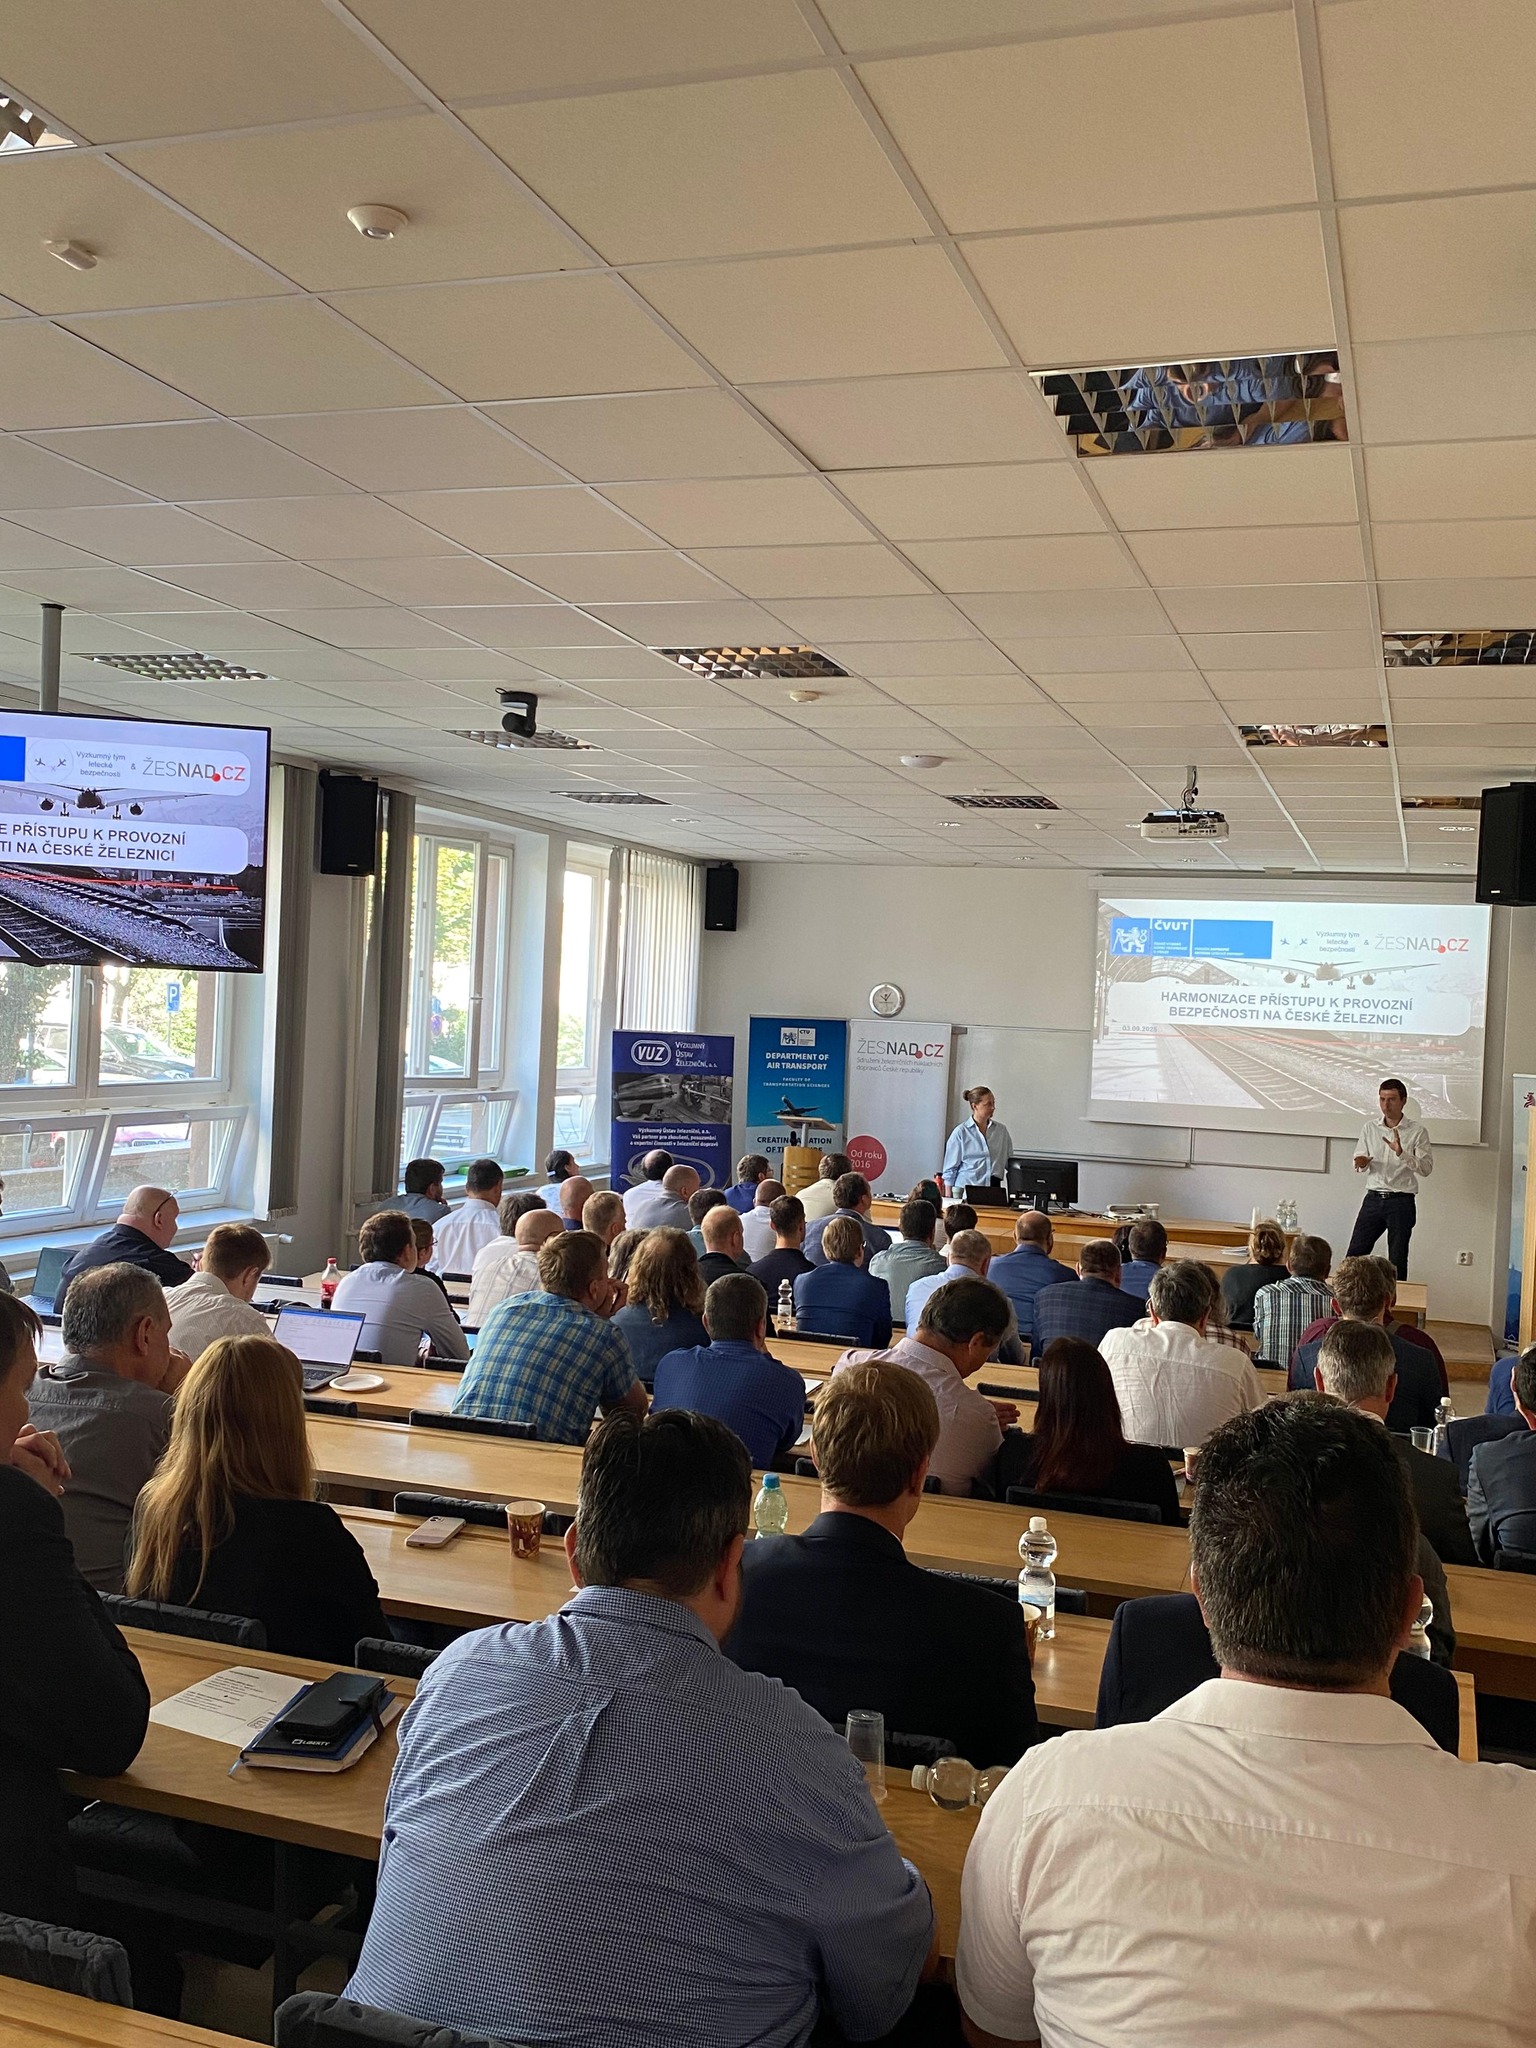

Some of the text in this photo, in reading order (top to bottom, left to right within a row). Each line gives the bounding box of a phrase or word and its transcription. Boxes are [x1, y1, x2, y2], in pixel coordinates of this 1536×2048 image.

[76, 751, 126, 762] Výzkumný tým
[88, 761, 113, 769] letecké
[142, 757, 246, 782] ŽESNAD.CZ
[80, 769, 121, 778] bezpečnosti
[12, 821, 88, 840] PŘÍSTUPU
[93, 829, 104, 841] K
[108, 829, 186, 846] PROVOZNÍ
[16, 841, 38, 854] NA
[42, 840, 94, 857] ČESKÉ
[97, 843, 175, 862] ŽELEZNICI
[1154, 919, 1189, 931] ČVUT
[1316, 931, 1347, 939] Výzkumný
[1374, 933, 1470, 953] ŽESNAD.CZ
[170, 986, 178, 1003] P
[1161, 991, 1413, 1011] HARMONIZACE PŘÍSTUPU K PROVOZNÍ
[1169, 1006, 1403, 1025] BEZPEČNOSTI NA ČESKÉ ŽELEZNICI
[638, 1046, 665, 1061] VUZ
[856, 1038, 944, 1059] ŽESNAD.CZ
[765, 1052, 817, 1060] DEPARTMENT
[781, 1062, 828, 1070] TRANSPORT
[757, 1136, 790, 1144] CREATIN
[850, 1149, 883, 1160] Od roku
[851, 1159, 871, 1169] 2016
